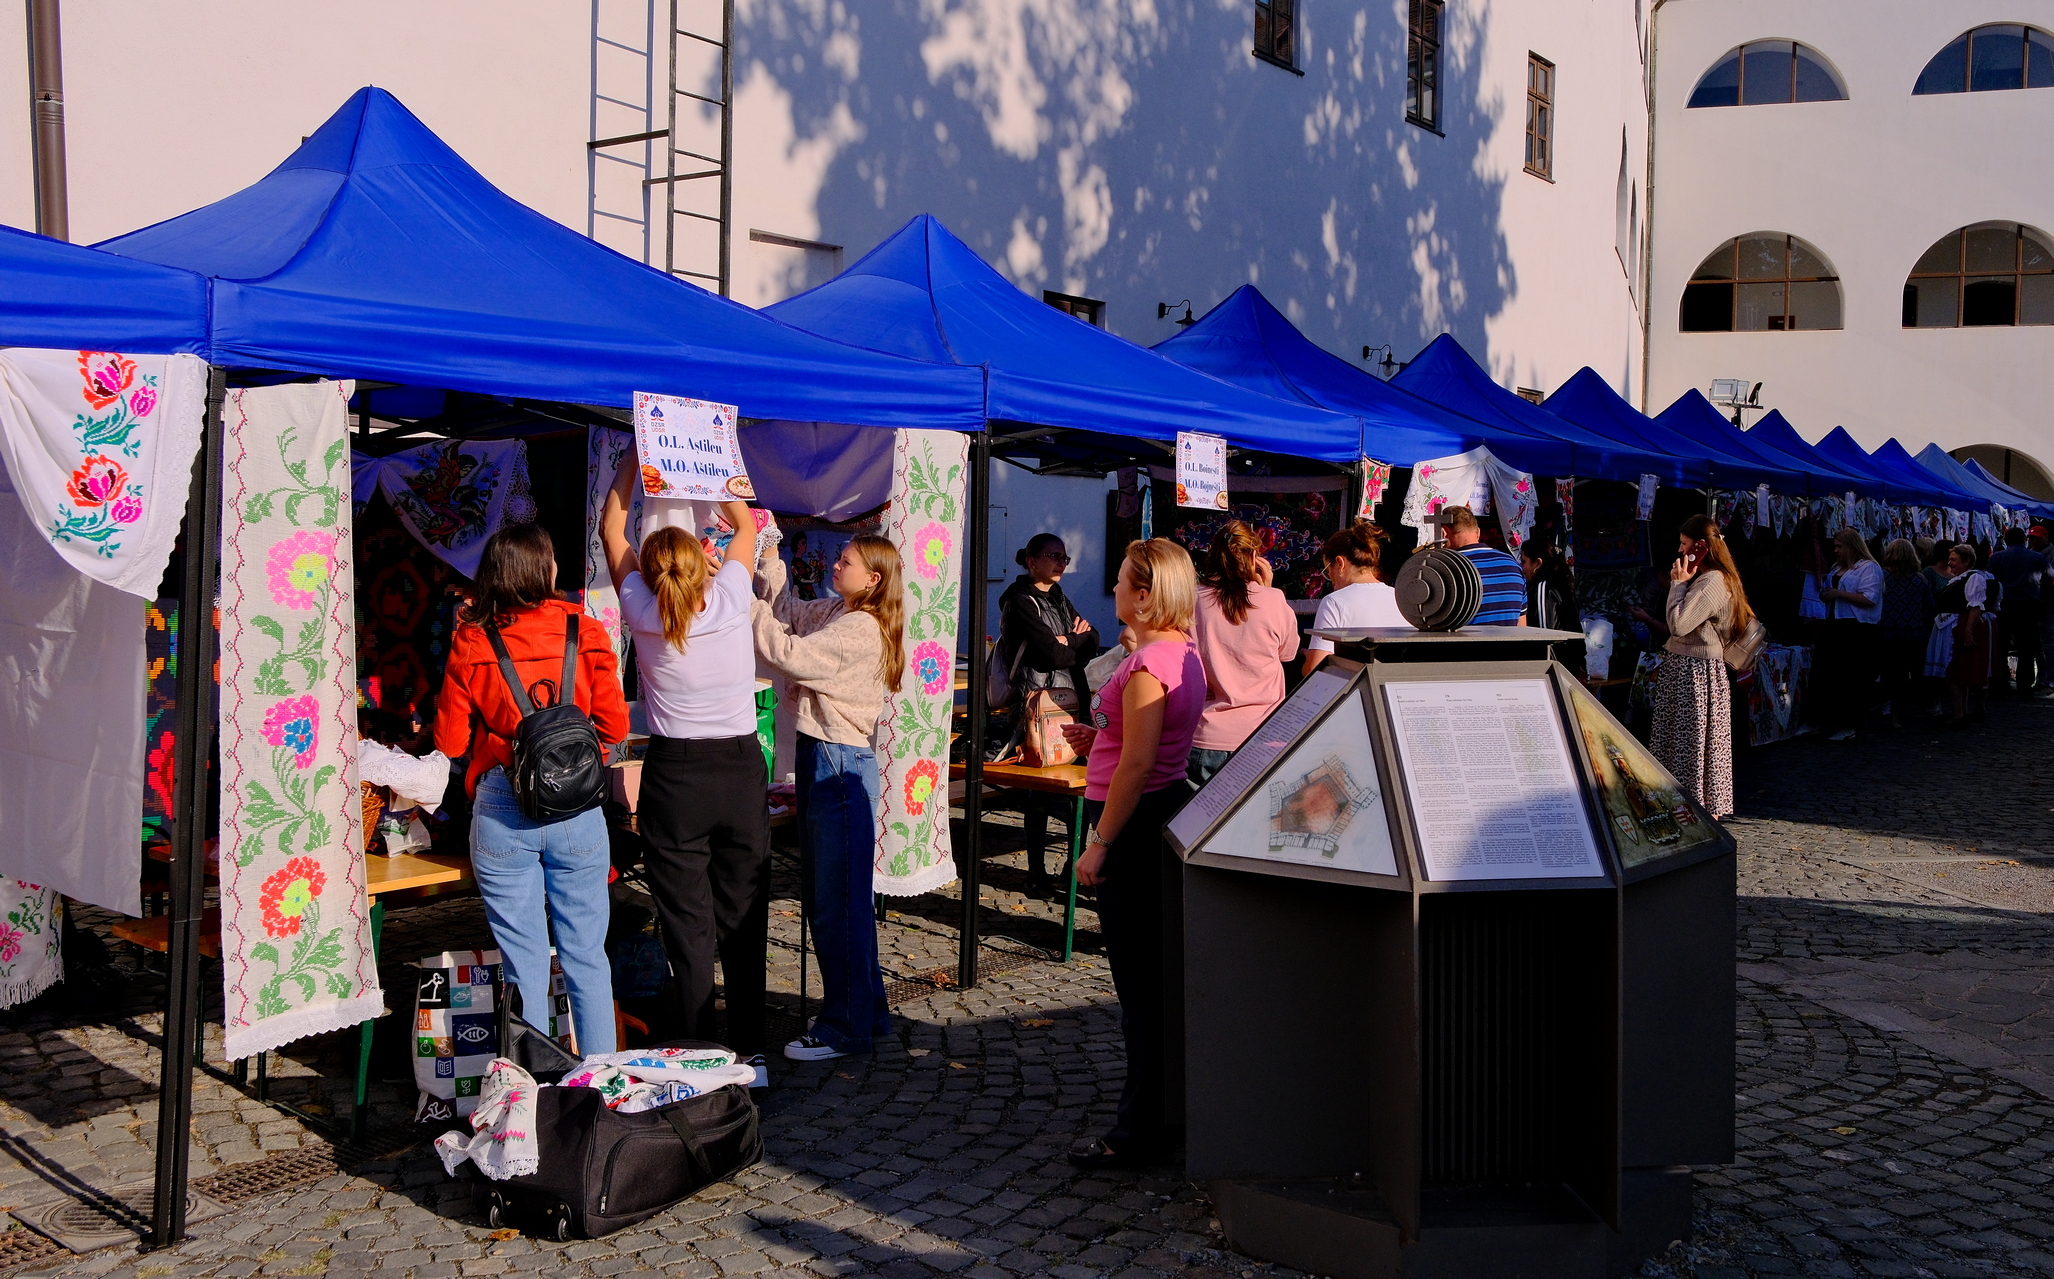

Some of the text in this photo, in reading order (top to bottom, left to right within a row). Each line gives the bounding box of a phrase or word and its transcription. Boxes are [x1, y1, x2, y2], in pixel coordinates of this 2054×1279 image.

[658, 434, 685, 449] O.L.
[660, 458, 729, 477] M.O. Aštileu
